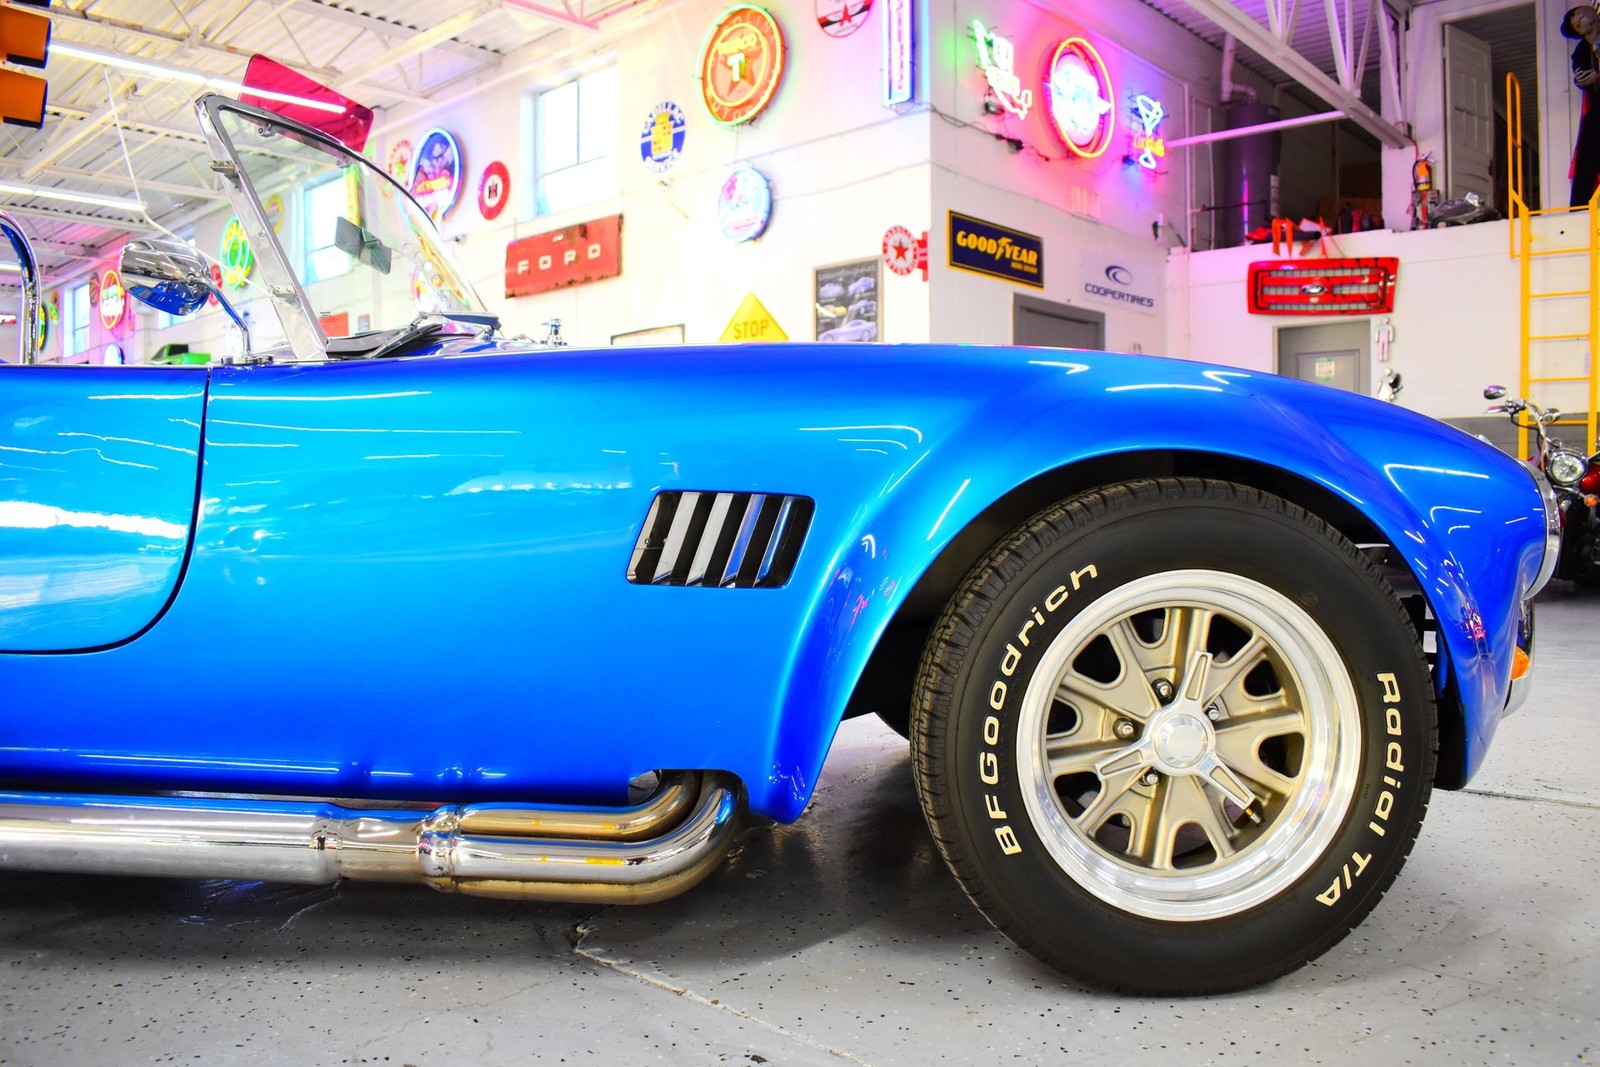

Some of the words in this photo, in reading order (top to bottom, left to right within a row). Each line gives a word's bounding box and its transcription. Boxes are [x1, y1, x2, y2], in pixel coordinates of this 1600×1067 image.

[517, 243, 601, 275] FORD
[956, 230, 1038, 266] GOODYEAR
[733, 319, 769, 340] STOP
[979, 563, 1099, 856] BFGoodrich
[1368, 672, 1405, 837] Radial
[1314, 851, 1373, 907] T/A
